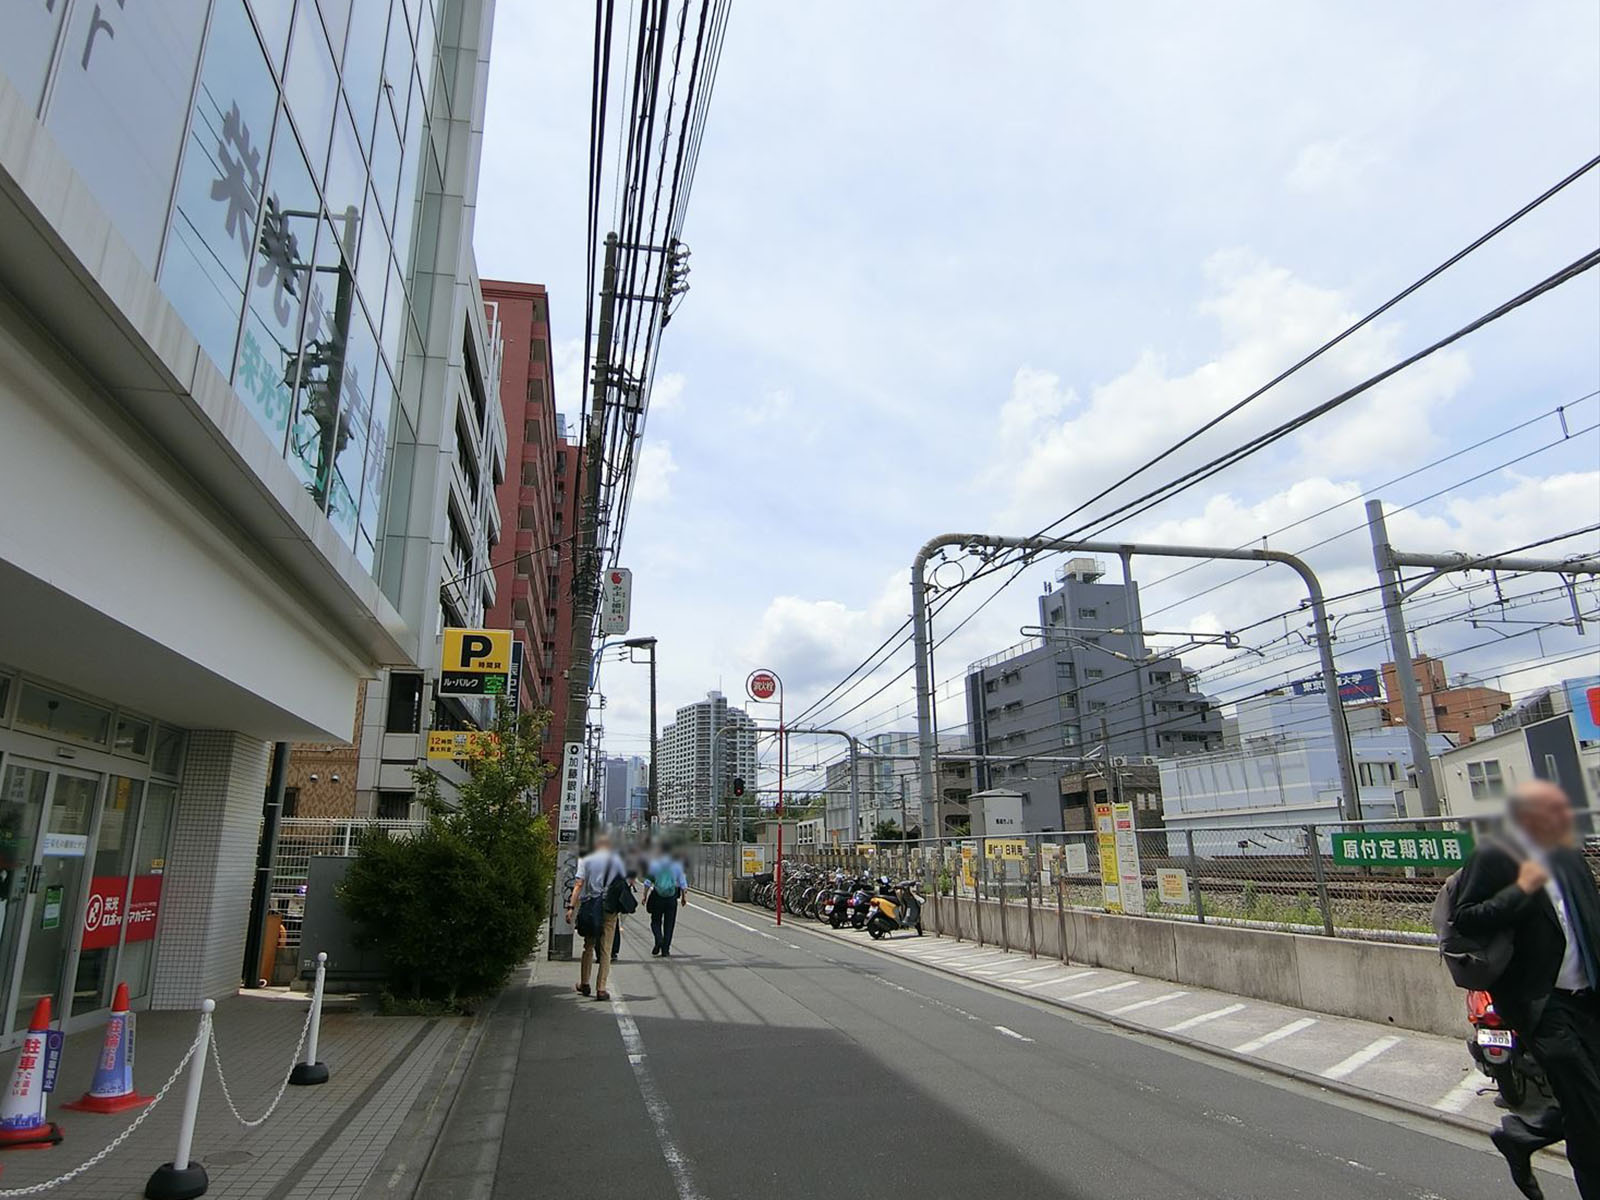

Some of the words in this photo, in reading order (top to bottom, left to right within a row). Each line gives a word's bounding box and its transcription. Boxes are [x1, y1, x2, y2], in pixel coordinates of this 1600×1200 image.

[460, 634, 493, 668] P
[1343, 838, 1462, 860] 原付定期利用
[18, 1038, 41, 1070] 駐車
